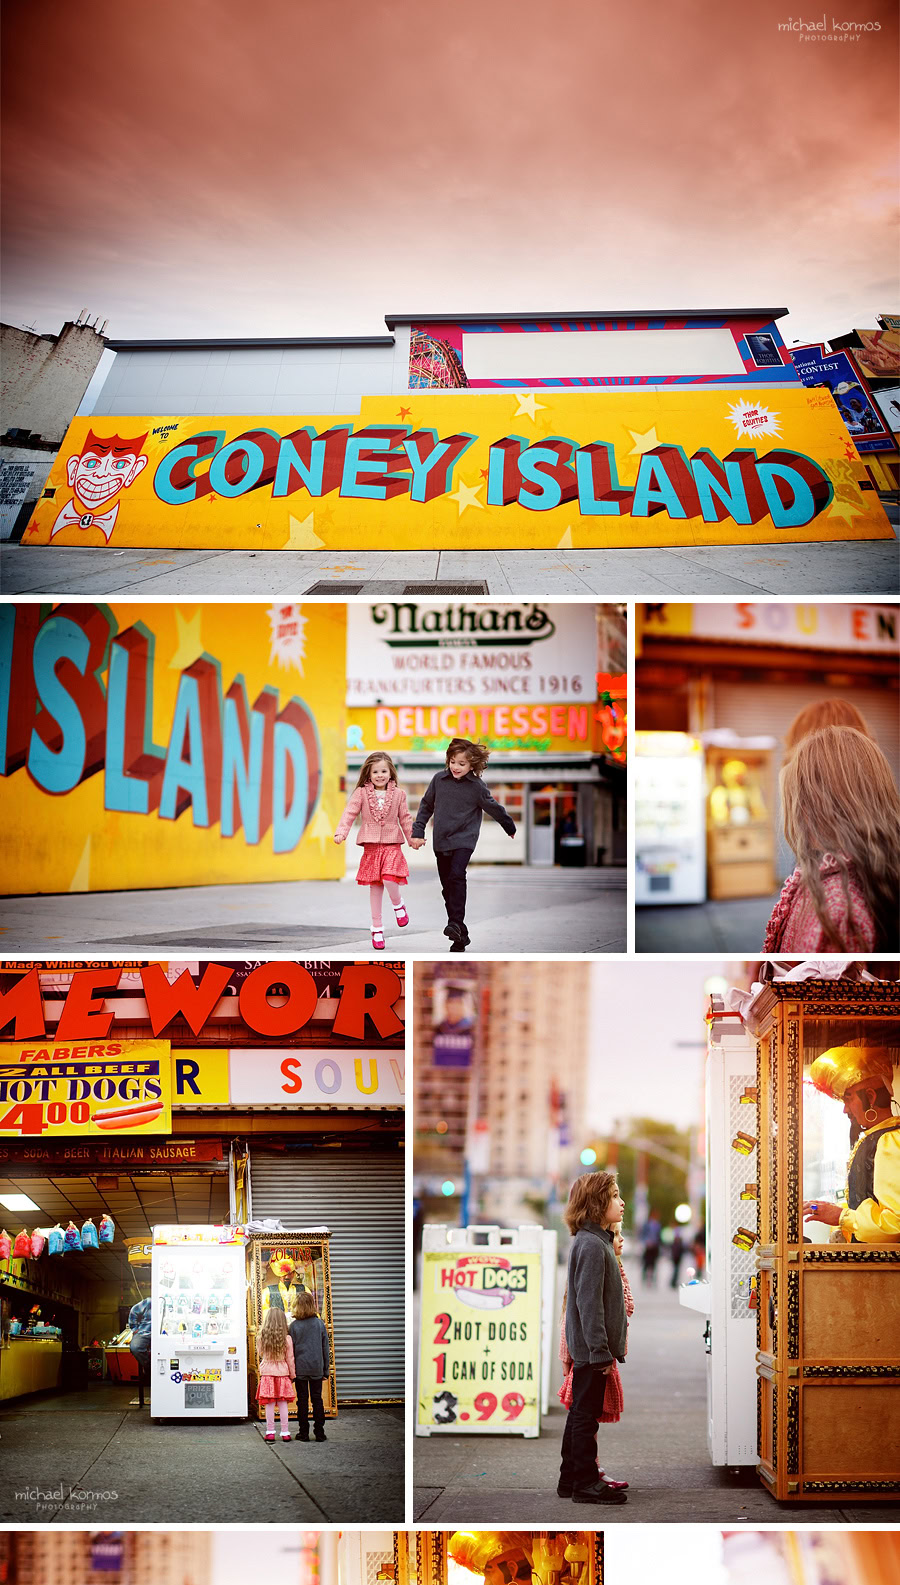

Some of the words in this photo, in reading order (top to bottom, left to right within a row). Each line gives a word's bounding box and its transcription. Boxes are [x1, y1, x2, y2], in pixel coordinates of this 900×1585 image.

[800, 362, 839, 375] CONTEST
[742, 416, 769, 427] EQUITIES
[743, 410, 759, 418] THOR
[152, 424, 179, 435] WELCOME
[153, 425, 472, 506] CONEY
[486, 435, 834, 529] ISLAND
[392, 654, 455, 671] WORLD
[460, 652, 532, 671] FAMOUS
[482, 676, 532, 693] SINCE
[540, 675, 583, 693] 1916
[375, 706, 588, 741] DELICATESSEN
[5, 961, 42, 970] Made
[45, 961, 83, 969] While
[86, 961, 110, 969] You
[19, 1043, 122, 1062] FABERS
[30, 1066, 79, 1077] ALL
[85, 1064, 151, 1075] BEEF
[67, 1078, 162, 1101] DOGS
[23, 1148, 49, 1158] SODA
[64, 1148, 90, 1158] BEER
[103, 1148, 144, 1158] ITALIAN
[150, 1147, 196, 1159] SAUSAGE
[270, 1247, 312, 1263] ZOLTAR
[441, 1268, 479, 1288] HOT
[484, 1266, 527, 1291] DOGS
[433, 1312, 452, 1345] 2
[453, 1322, 482, 1341] HOT
[488, 1322, 527, 1342] DOGS
[432, 1352, 447, 1384] 1
[452, 1360, 477, 1381] CAN
[482, 1361, 496, 1381] OF
[501, 1361, 534, 1382] SODA
[433, 1390, 526, 1425] 3.99
